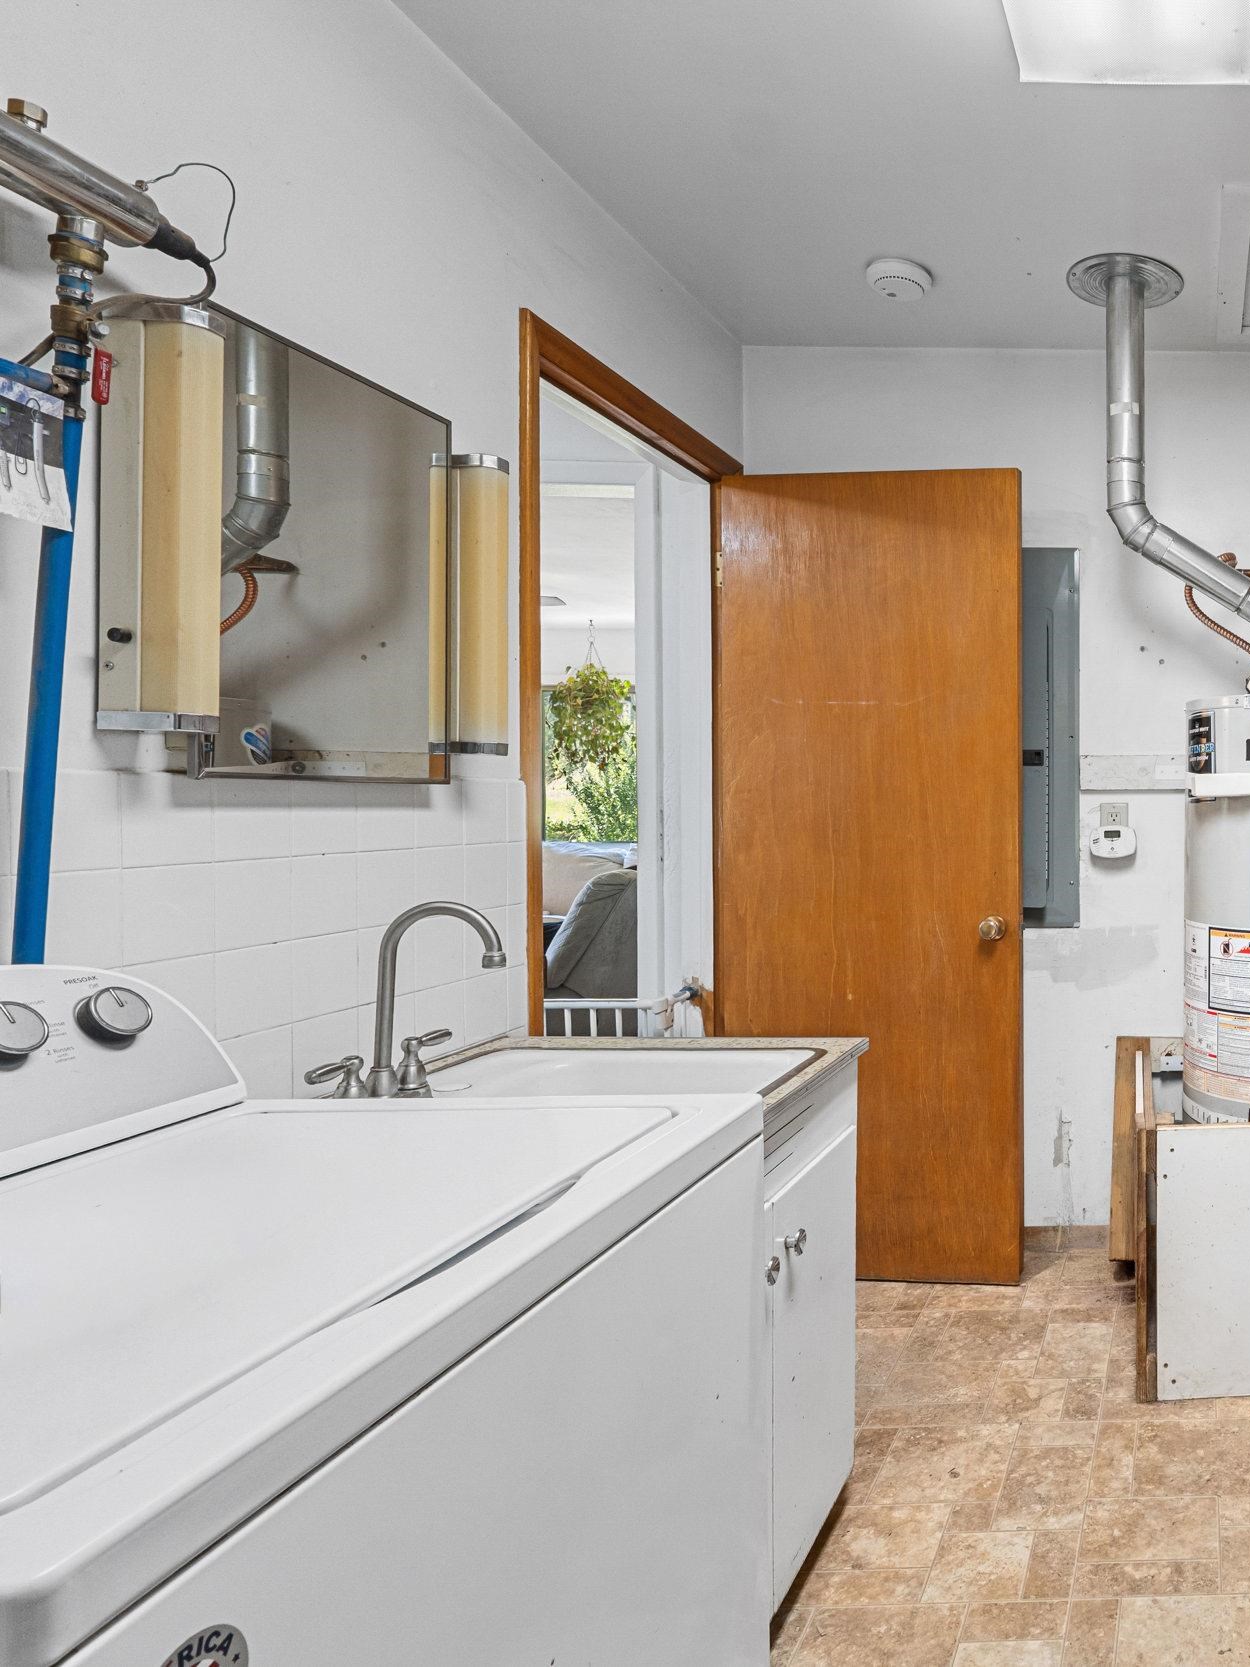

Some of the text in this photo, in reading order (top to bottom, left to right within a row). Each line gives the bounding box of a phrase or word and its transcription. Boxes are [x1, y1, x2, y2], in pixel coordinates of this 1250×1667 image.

[63, 976, 98, 985] PRESOAK
[53, 1046, 75, 1054] Rinses
[168, 1630, 234, 1667] RICA
